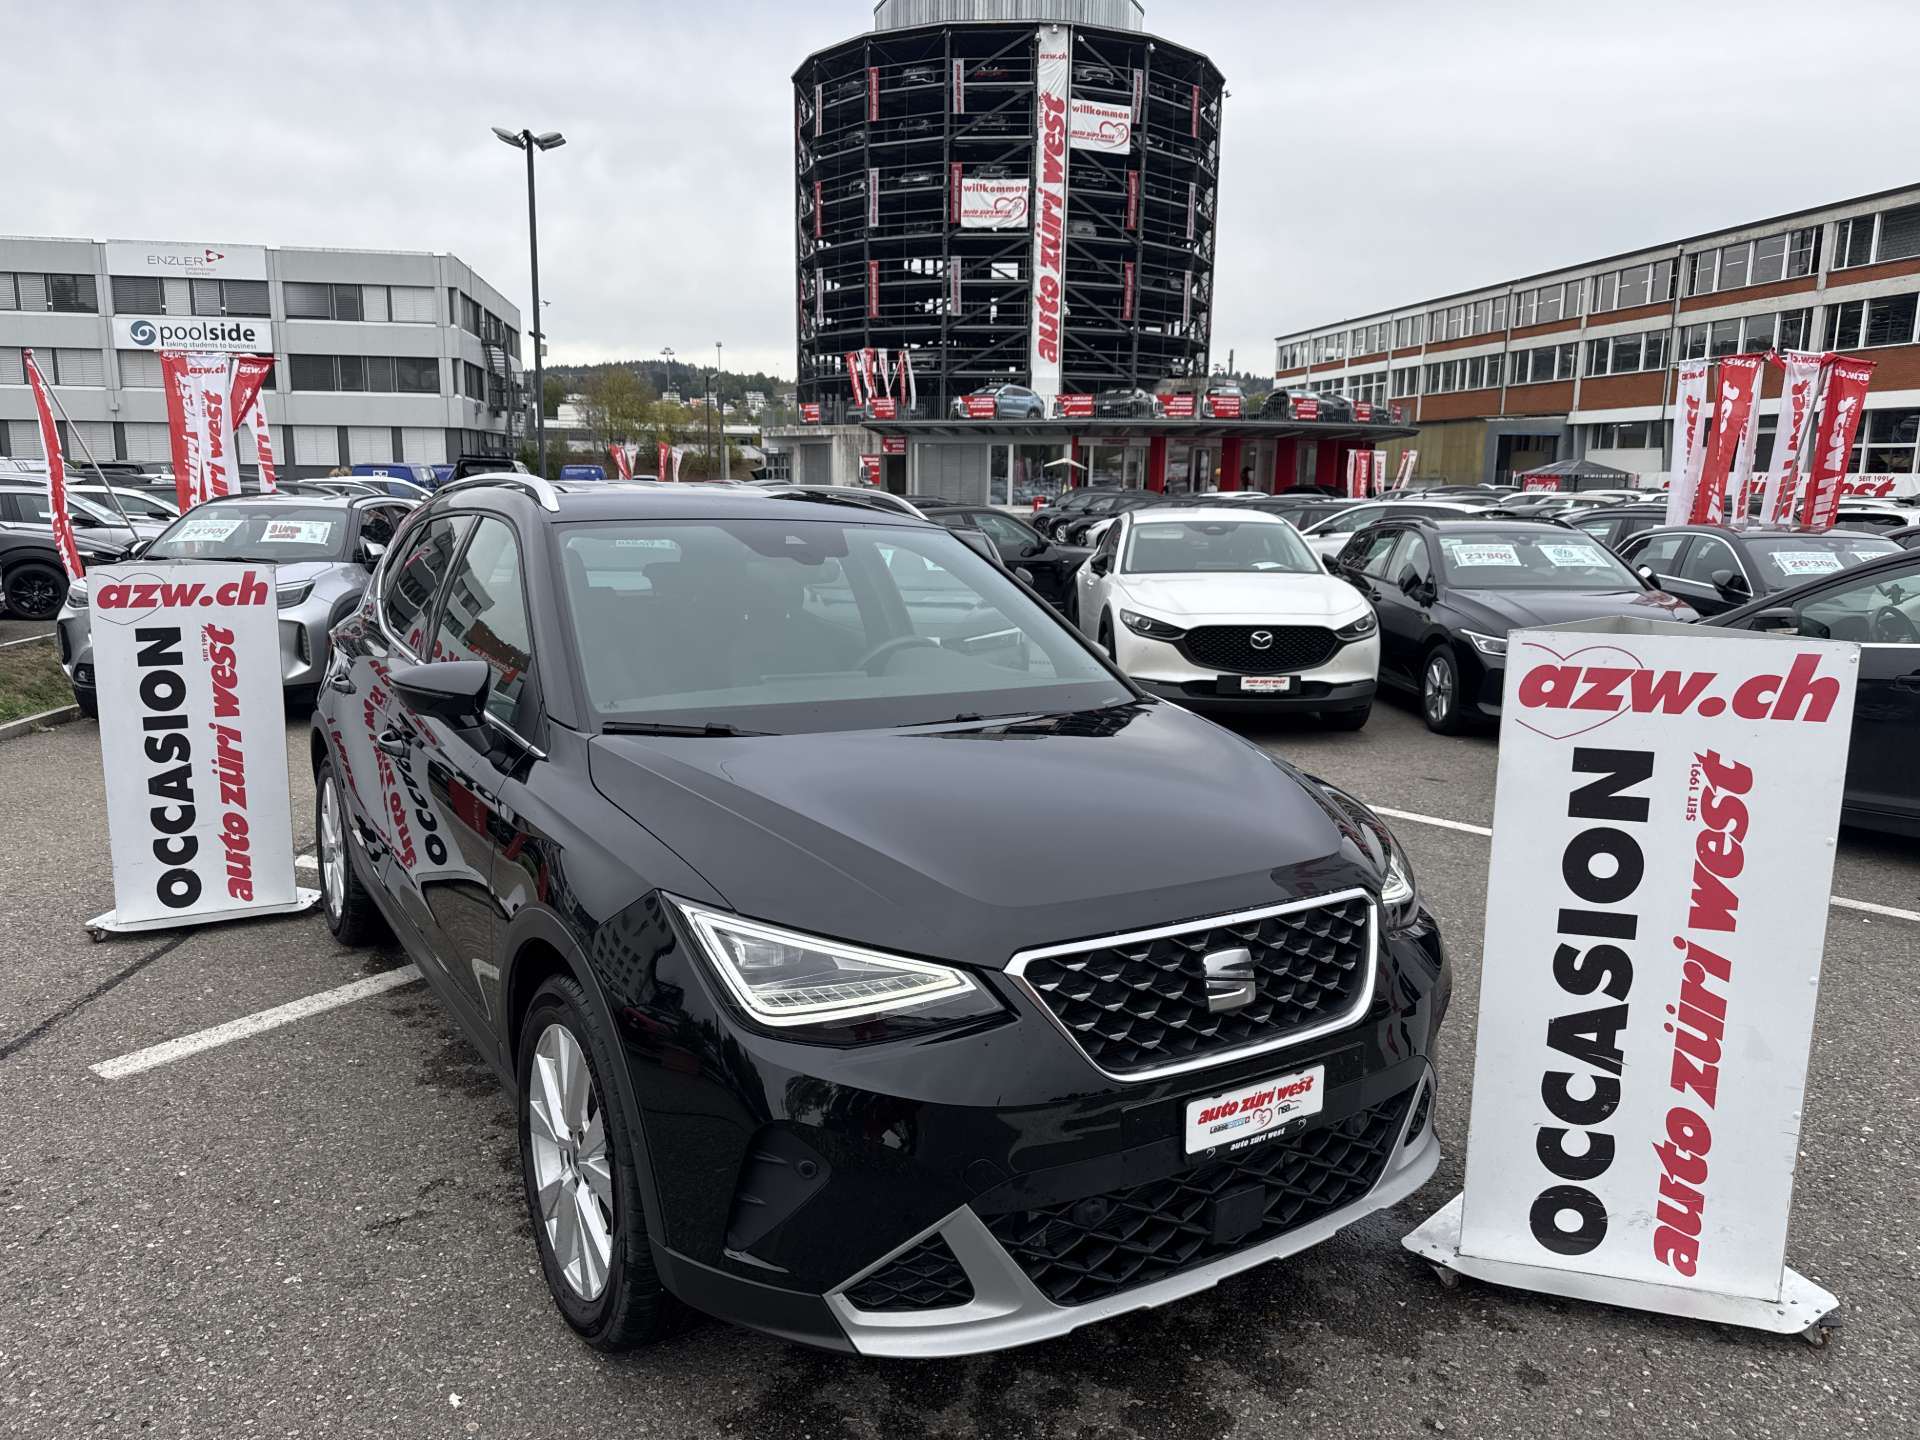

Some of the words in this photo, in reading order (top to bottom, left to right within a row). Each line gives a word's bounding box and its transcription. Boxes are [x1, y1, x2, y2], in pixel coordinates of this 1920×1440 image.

[1040, 52, 1067, 60] azw.ch
[1071, 104, 1130, 119] willkommen
[1040, 90, 1065, 183] west
[963, 183, 1027, 192] willkommen
[1036, 188, 1063, 274] züri
[147, 255, 203, 266] ENZLER
[160, 321, 255, 347] poolside
[1035, 275, 1060, 364] auto
[166, 341, 188, 349] taking
[189, 364, 226, 375] azw.ch
[205, 389, 223, 458] west
[206, 461, 229, 497] üri
[1840, 478, 1896, 496] est
[1465, 552, 1512, 560] 23'800
[96, 571, 269, 609] azw.ch
[201, 623, 240, 718] west
[1518, 654, 1841, 722] azw.ch
[135, 626, 202, 909] OCCASION
[209, 723, 247, 810] züri
[1689, 764, 1701, 791] 1991
[1686, 796, 1698, 821] SEIT
[217, 812, 254, 902] auto
[1688, 749, 1753, 933] west
[1529, 748, 1655, 1255] OCCASION
[1663, 936, 1733, 1110] züri
[1197, 1100, 1239, 1126] auto
[1239, 1087, 1276, 1113] züri
[1277, 1075, 1314, 1100] west
[1230, 1139, 1248, 1151] auto
[1250, 1133, 1267, 1144] züri
[1268, 1127, 1285, 1139] west
[1651, 1106, 1713, 1278] auto
